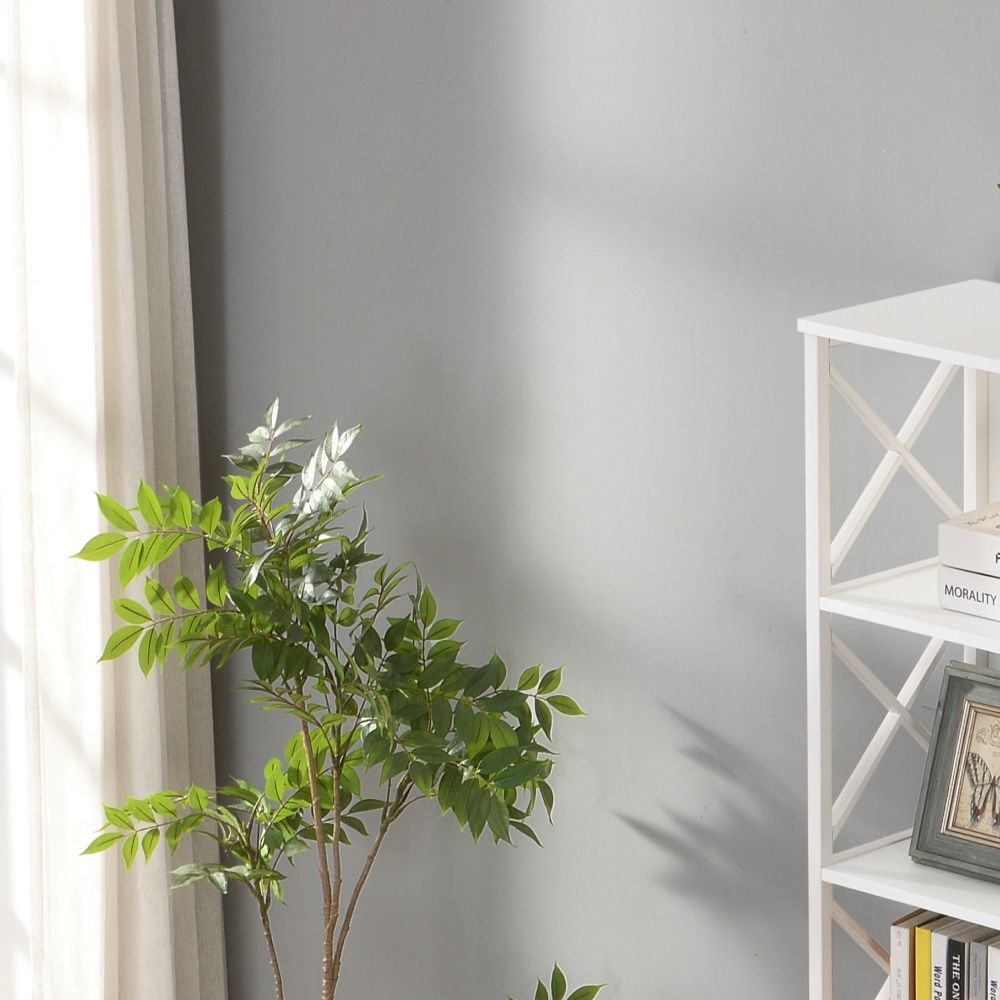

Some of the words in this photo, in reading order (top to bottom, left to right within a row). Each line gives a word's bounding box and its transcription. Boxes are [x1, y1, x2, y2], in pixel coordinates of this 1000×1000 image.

[944, 584, 997, 606] MORALITY
[933, 966, 943, 989] Word
[952, 954, 961, 980] THE
[990, 980, 998, 1000] Word
